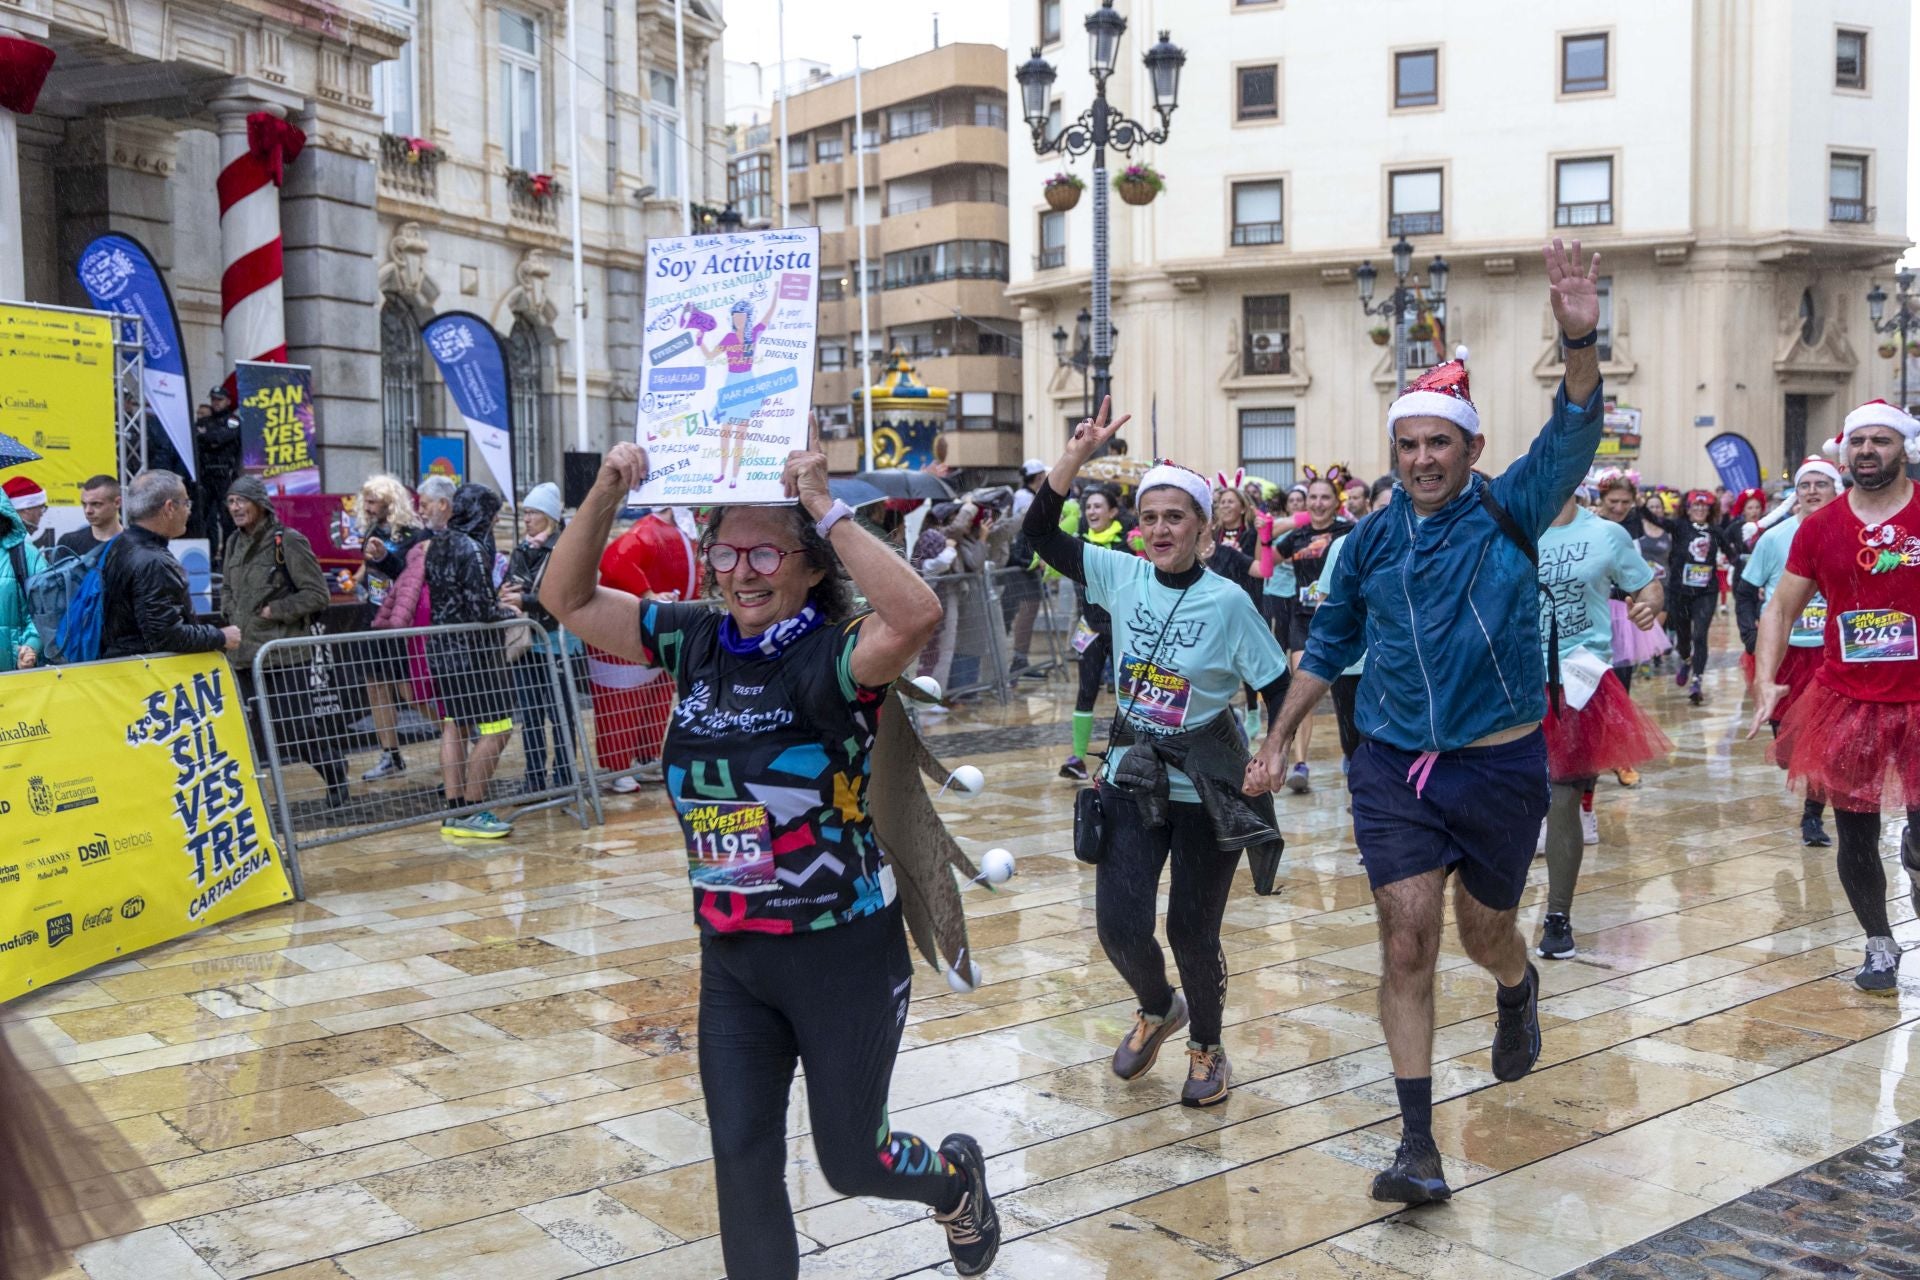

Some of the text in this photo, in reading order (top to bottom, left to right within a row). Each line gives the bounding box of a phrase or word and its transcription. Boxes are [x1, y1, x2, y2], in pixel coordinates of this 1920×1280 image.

[656, 249, 811, 282] Soy Activista
[712, 281, 721, 291] Y
[721, 270, 773, 290] SANIDAD
[779, 322, 813, 330] Tercera
[759, 337, 807, 349] PENSIONES
[764, 349, 799, 360] DIGNAS
[653, 373, 700, 384] IGUALDAD
[258, 384, 303, 408] SAN
[721, 373, 794, 404] MAR MENOR VIVO
[5, 396, 48, 409] CaixaBank
[266, 404, 299, 427] SIL
[727, 416, 764, 428] SUELOS
[750, 408, 794, 418] GENOCIDIO
[263, 422, 305, 446] VES
[696, 427, 790, 444] DESCONTAMINADOS
[265, 441, 307, 465] TRE
[661, 444, 700, 453] RACISMO
[263, 459, 314, 477] CARTAGENA
[678, 458, 691, 468] YA
[665, 473, 714, 484] MOVILIDAD
[663, 484, 713, 496] SOSTENIBLE
[1856, 612, 1875, 621] SAN
[1854, 626, 1902, 644] 2249
[1129, 677, 1176, 710] 1297
[142, 668, 225, 742] SAN
[168, 721, 228, 786] SIL
[54, 784, 97, 801] Cartagena
[171, 759, 244, 836] VES
[692, 806, 765, 833] SILVESTRE
[113, 831, 153, 850] berbois
[183, 806, 259, 886] TRE
[693, 831, 760, 863] 1195
[38, 851, 71, 866] MARNYS
[78, 840, 110, 862] DSM
[188, 847, 272, 919] CARTAGENA
[49, 914, 71, 928] AQUA
[50, 925, 71, 937] DEUS
